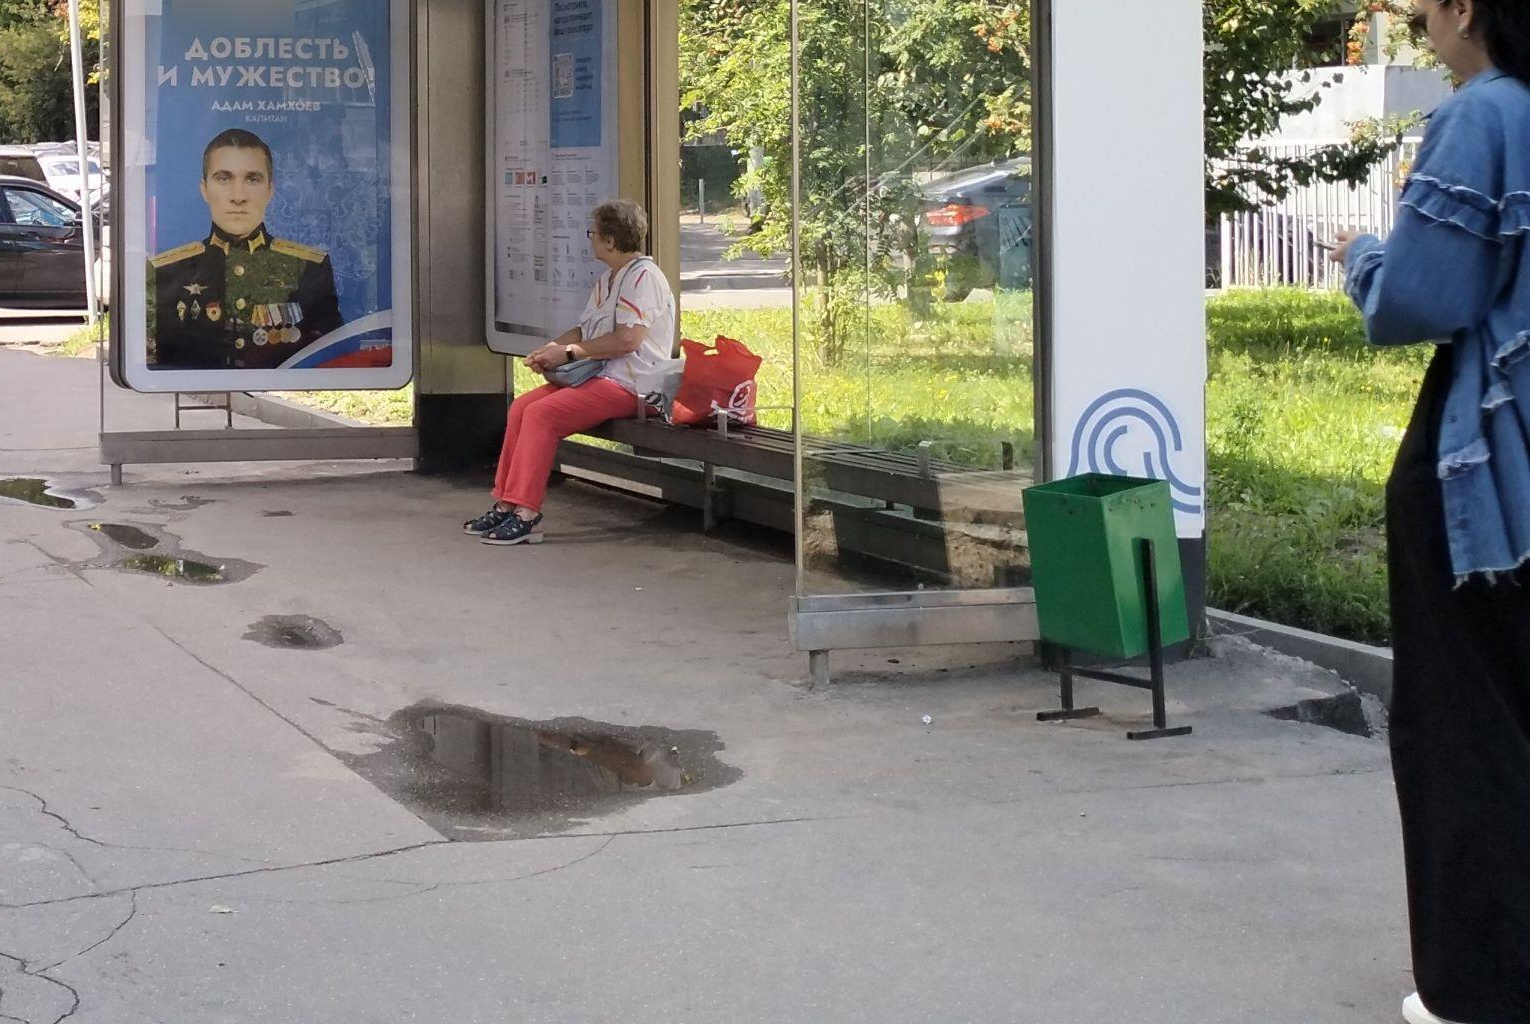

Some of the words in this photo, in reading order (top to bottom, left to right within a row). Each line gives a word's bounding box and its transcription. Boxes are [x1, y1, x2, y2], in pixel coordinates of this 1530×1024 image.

[184, 37, 349, 61] ДОБЛЕСТЬ
[158, 65, 178, 87] И
[191, 65, 364, 88] МУЖЕСТВО
[211, 100, 253, 111] АДАМ
[257, 100, 321, 112] ХАМХОЕВ
[245, 115, 287, 123] КАПИТАН
